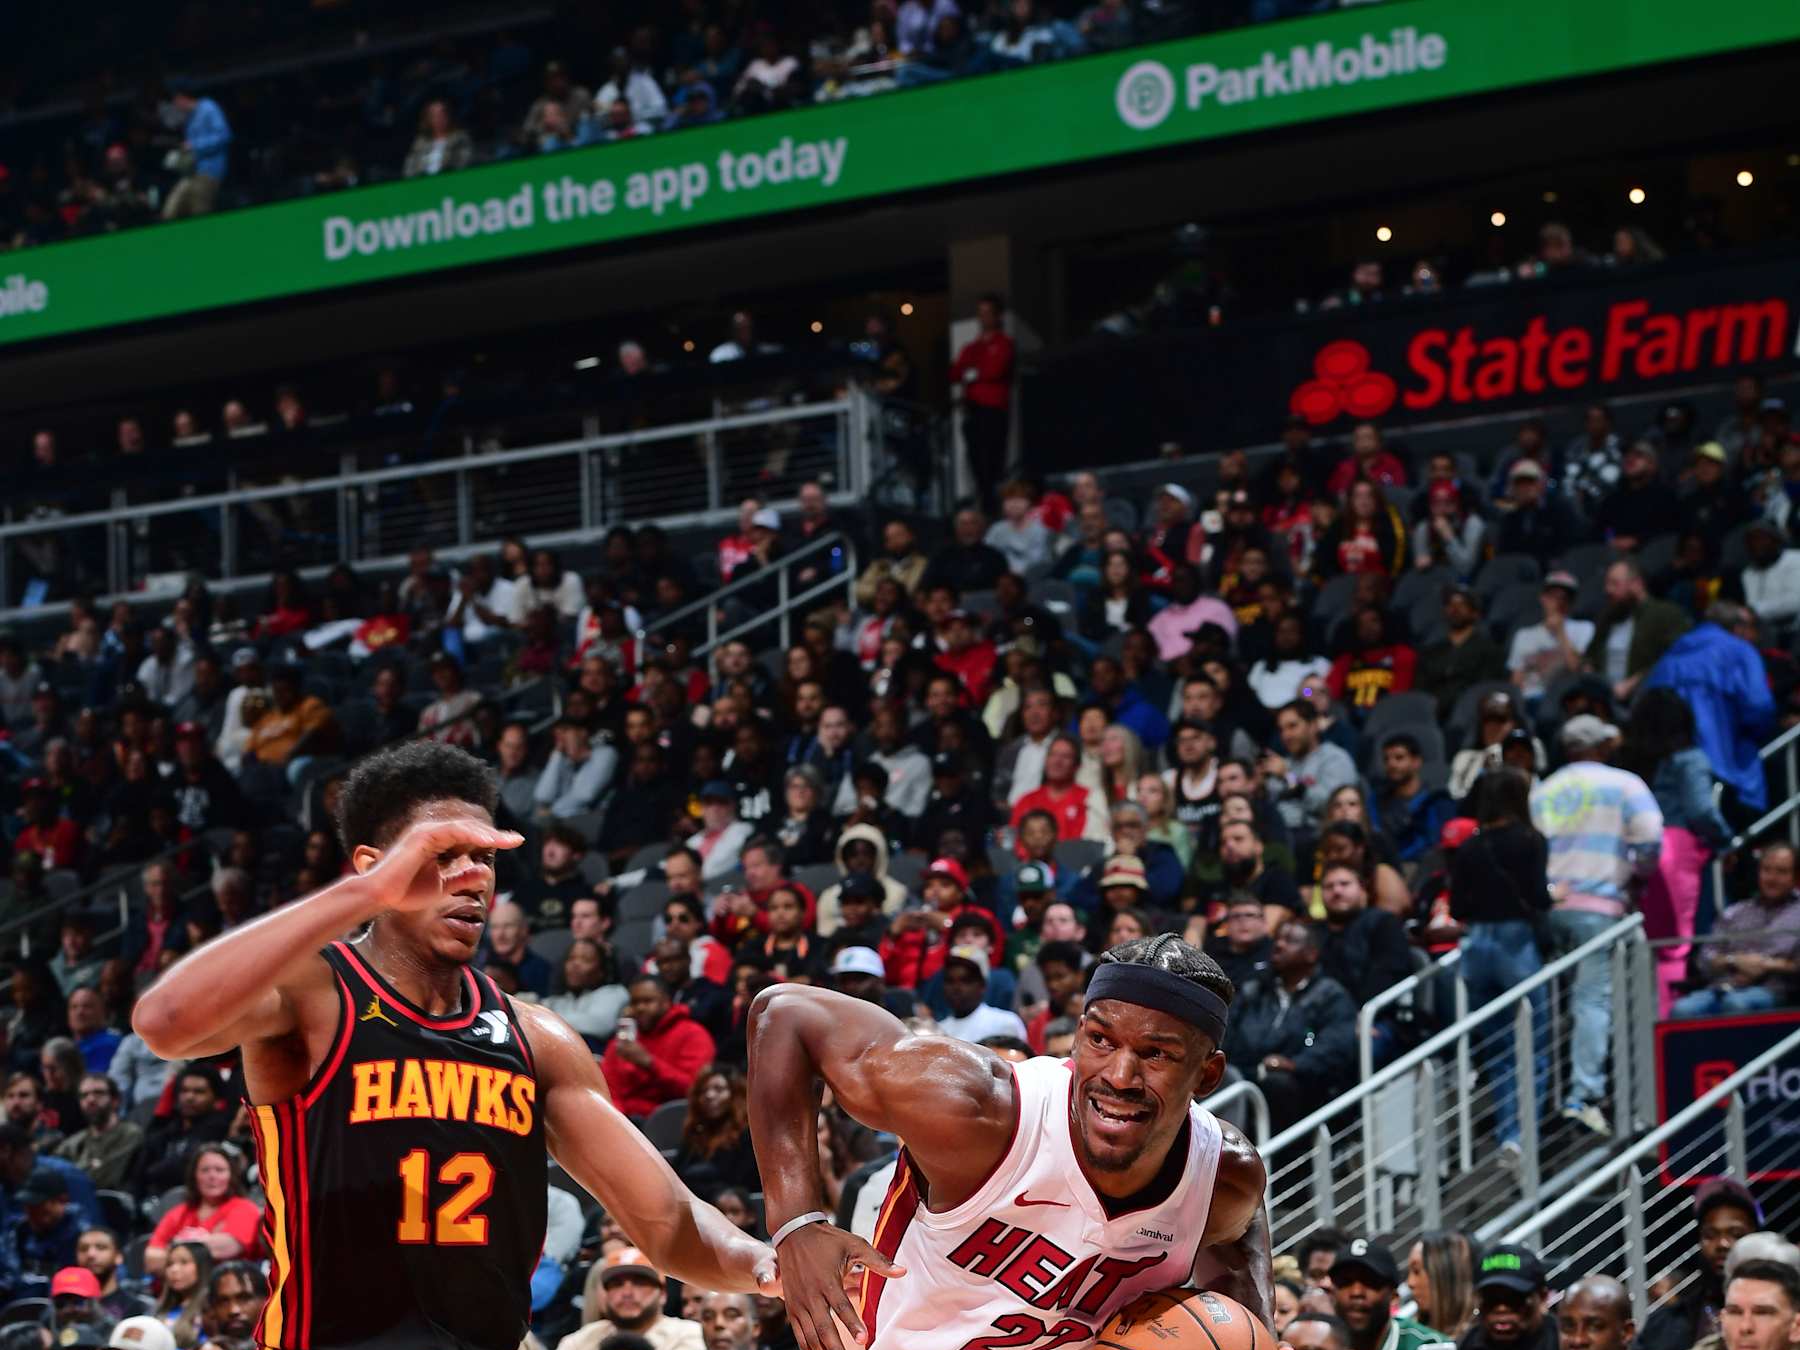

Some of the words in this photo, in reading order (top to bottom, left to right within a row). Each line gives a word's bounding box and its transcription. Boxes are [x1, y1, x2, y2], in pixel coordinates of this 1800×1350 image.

[1186, 26, 1447, 111] ParkMobile
[323, 184, 533, 261] Download
[543, 176, 616, 222] the
[624, 163, 709, 214] app
[718, 136, 848, 192] today
[1403, 314, 1592, 410] State
[1601, 298, 1788, 382] Farm
[350, 1058, 536, 1136] HAWKS
[398, 1148, 496, 1246] 12
[1136, 1227, 1174, 1242] Carnival
[946, 1216, 1168, 1317] HEAT
